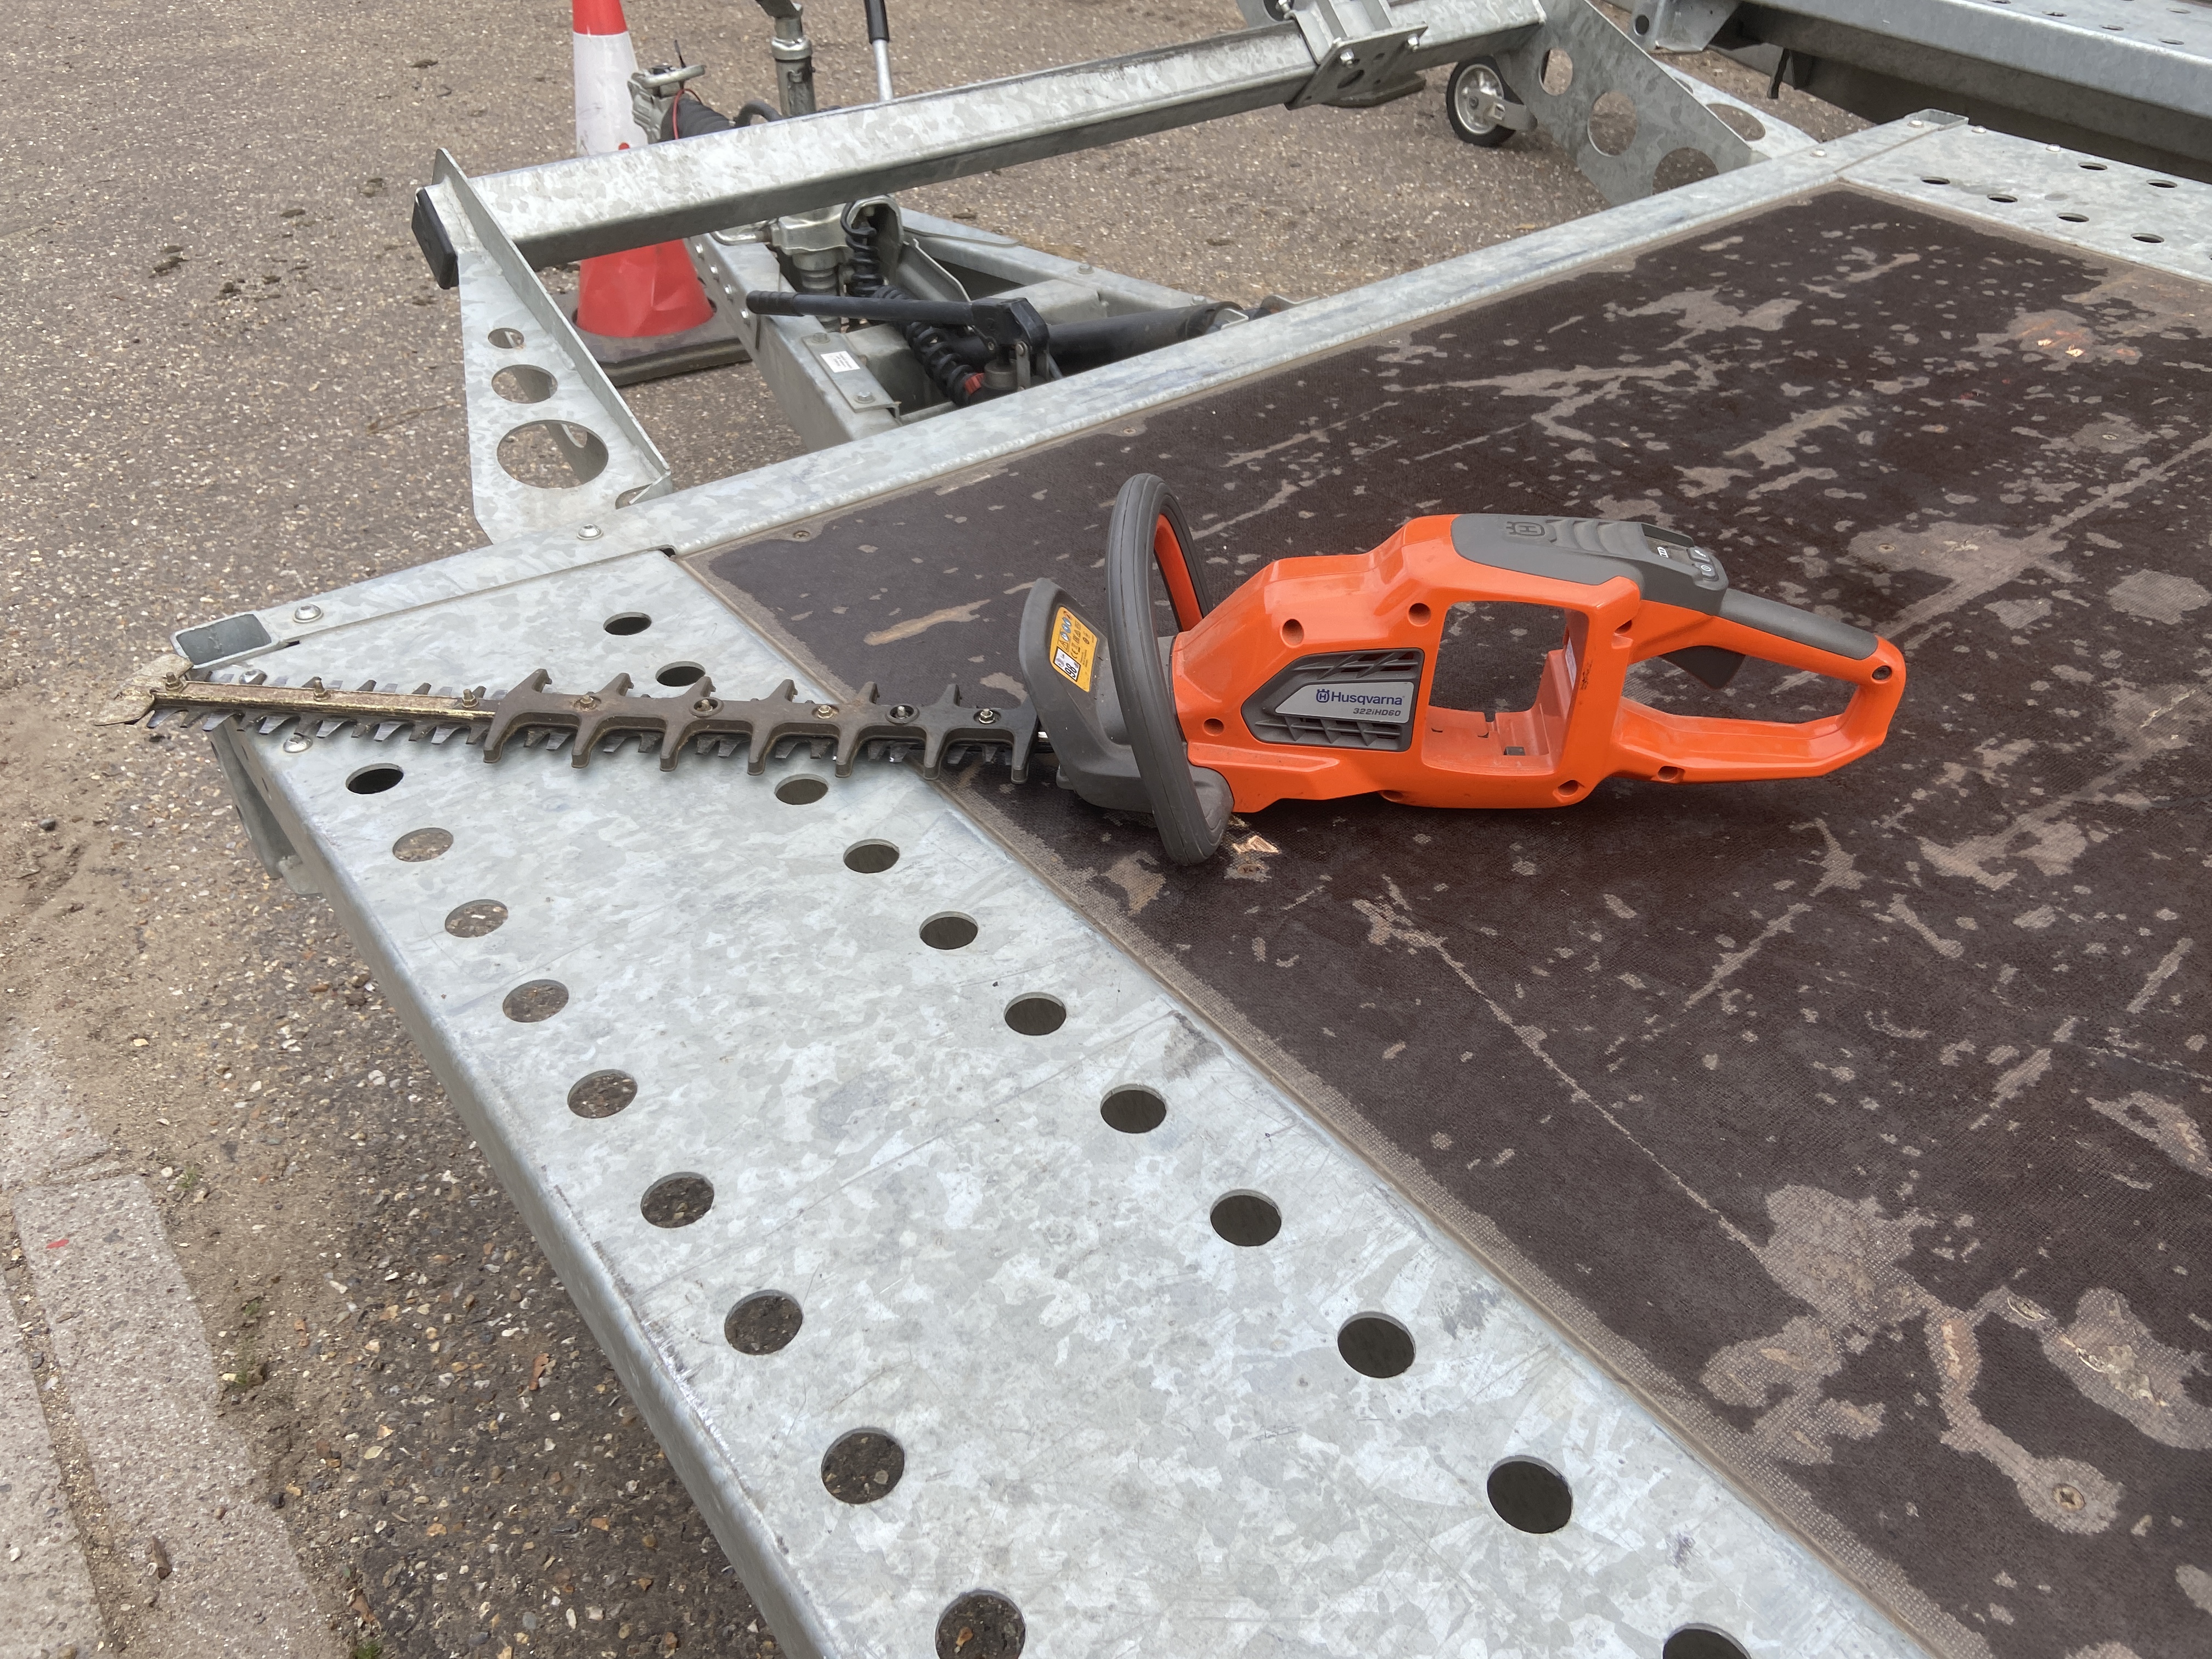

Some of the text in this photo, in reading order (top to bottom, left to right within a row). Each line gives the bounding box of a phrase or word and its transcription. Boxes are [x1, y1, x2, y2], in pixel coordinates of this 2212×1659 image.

[1065, 663, 1077, 678] 98
[1331, 692, 1402, 705] Husqvarna
[1353, 708, 1401, 716] 322iHD60
